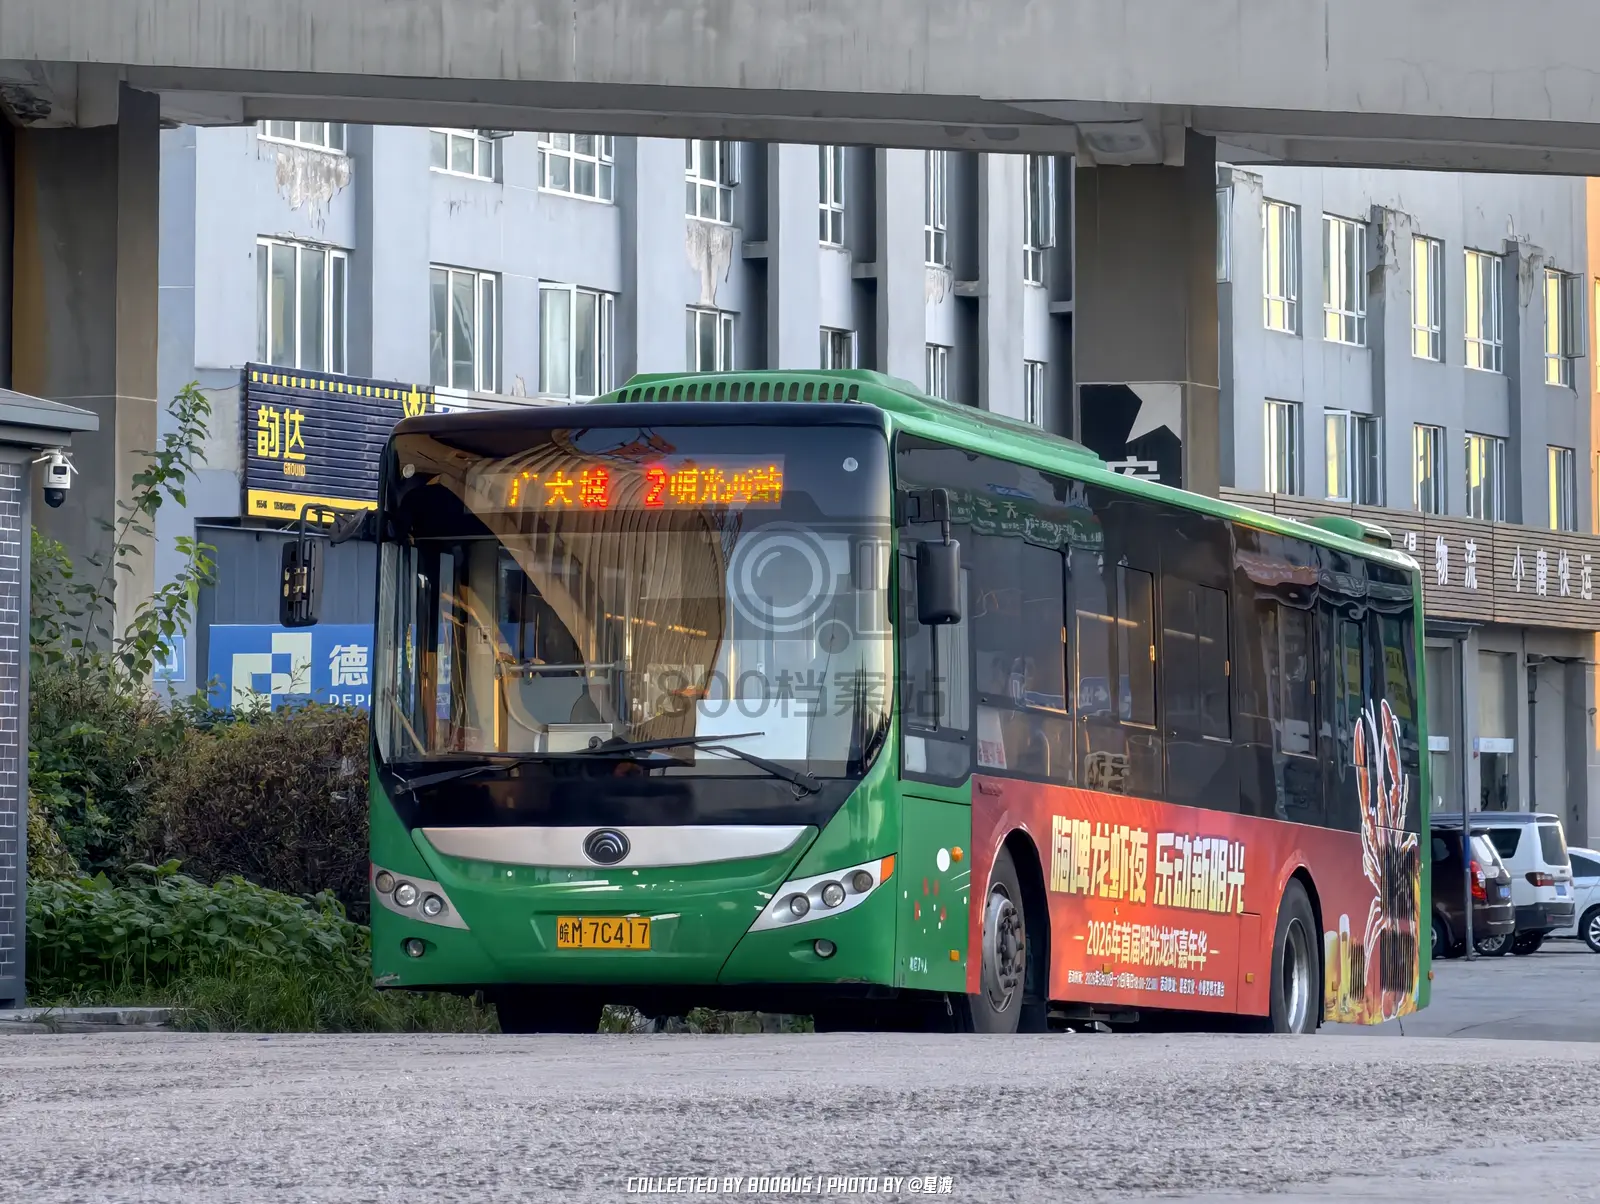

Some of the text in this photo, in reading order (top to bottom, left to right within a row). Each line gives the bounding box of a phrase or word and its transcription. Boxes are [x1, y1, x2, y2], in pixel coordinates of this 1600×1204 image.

[257, 400, 306, 460] 韵达
[644, 468, 667, 507] 2
[329, 644, 369, 686] 德
[1051, 814, 1245, 914] 嗨啤龙虾夜 乐动新明光
